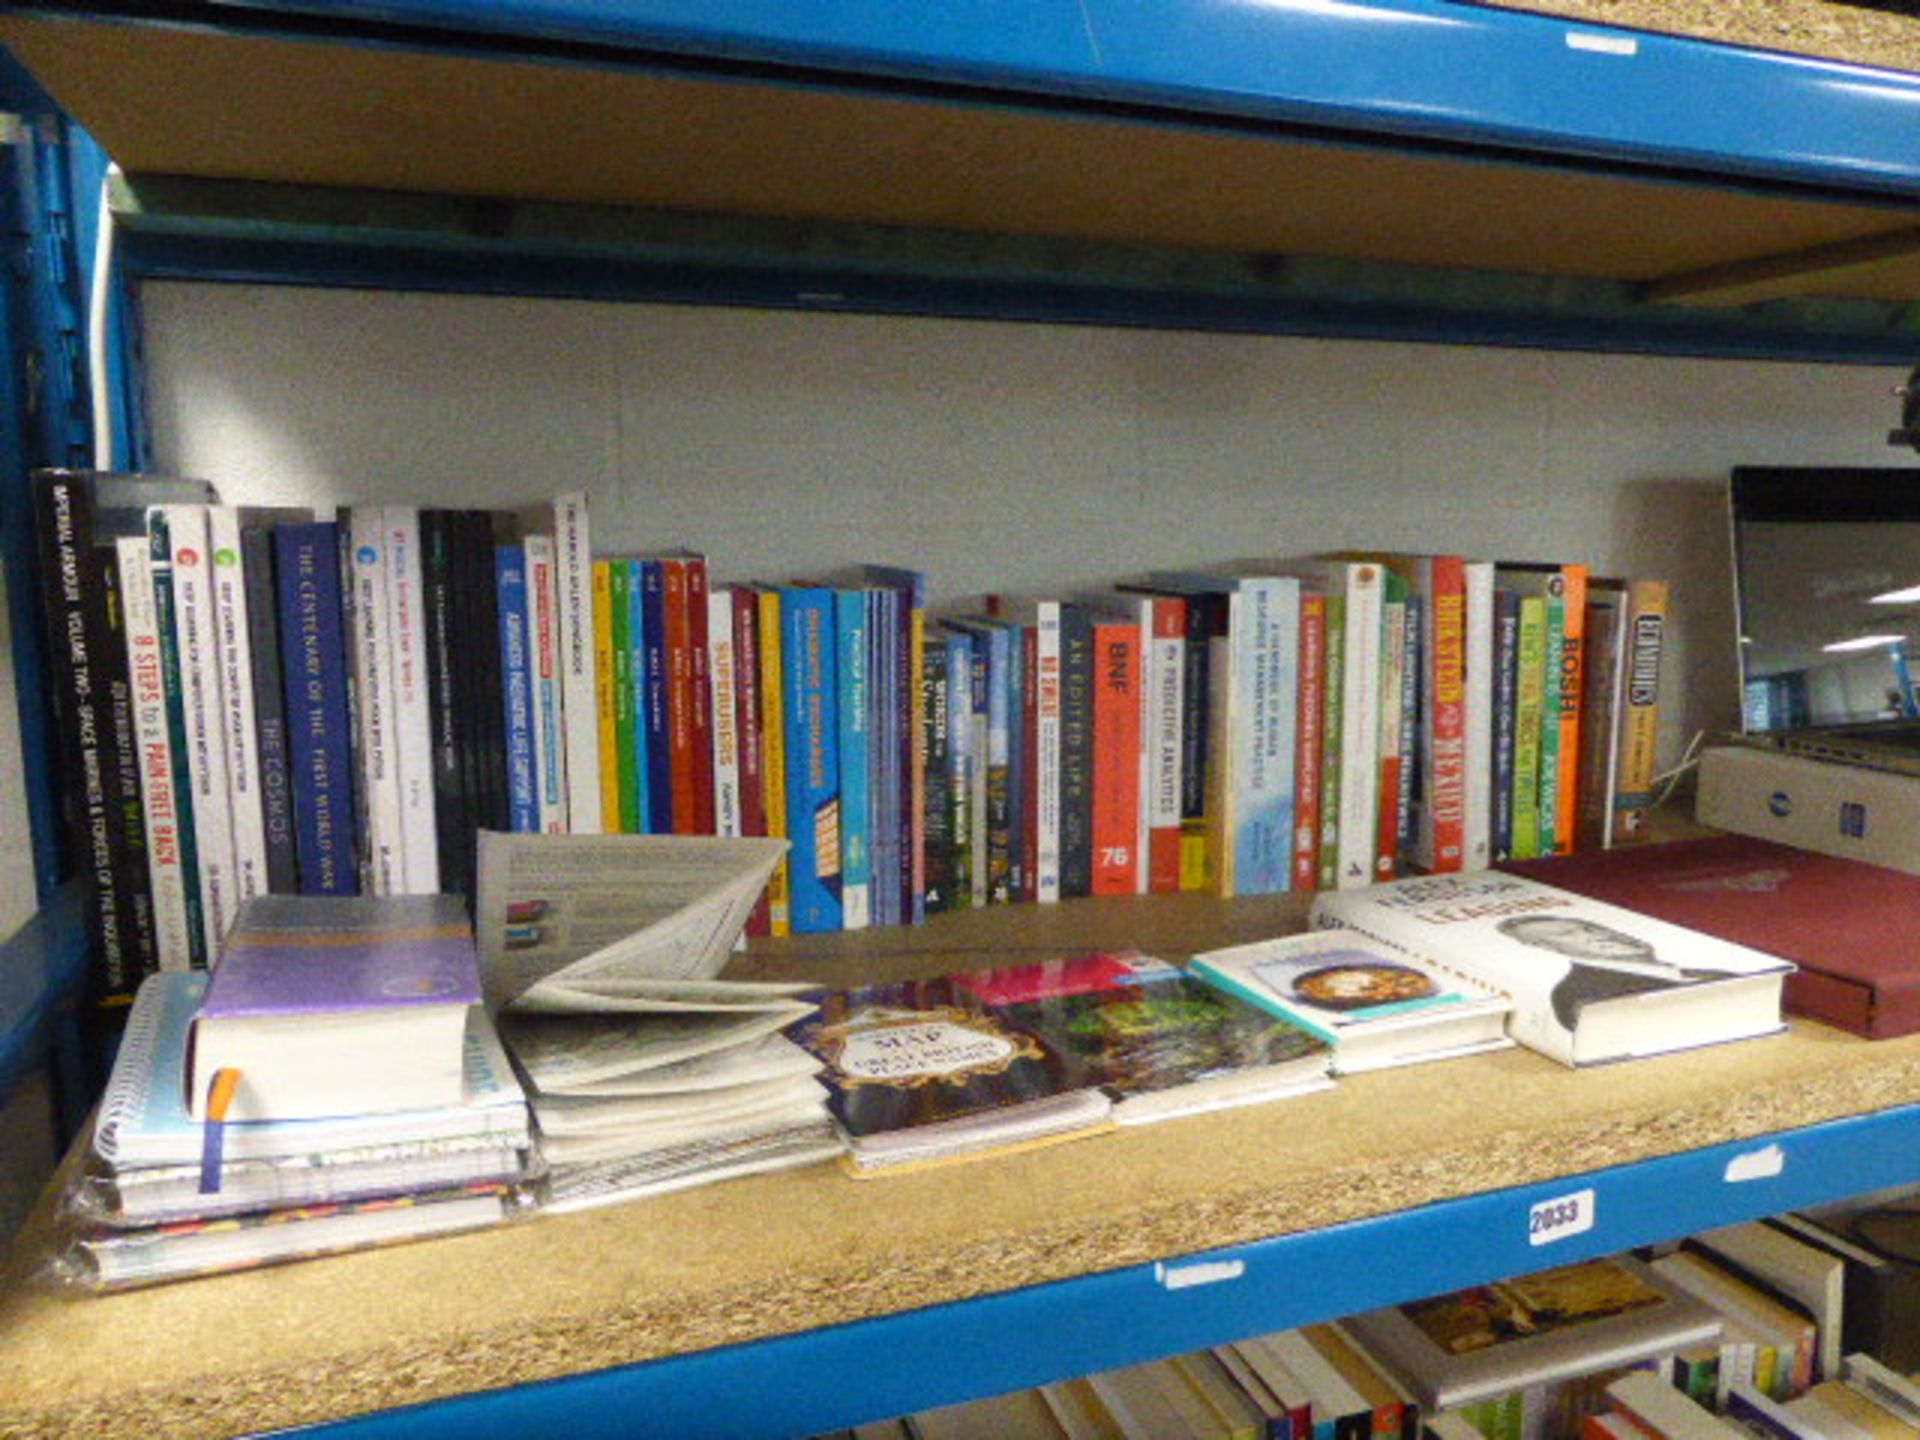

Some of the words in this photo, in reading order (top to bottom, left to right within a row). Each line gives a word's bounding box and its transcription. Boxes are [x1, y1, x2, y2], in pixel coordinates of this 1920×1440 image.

[53, 486, 72, 542] IMPERIAL
[61, 545, 79, 601] ARMOUR
[299, 545, 314, 576] THE
[67, 611, 88, 664] VOLUME
[301, 582, 321, 674] CENTENARY
[1256, 590, 1267, 649] RESOURCE
[135, 635, 156, 646] 8
[1069, 639, 1084, 665] AN
[74, 667, 91, 696] TWO
[136, 654, 161, 704] STEPS
[1041, 656, 1058, 674] NO
[1108, 642, 1129, 696] BNF
[308, 679, 323, 700] OF
[1068, 674, 1084, 745] EDITED
[1162, 668, 1178, 742] PREDICTIVE
[1254, 654, 1266, 733] MANAGEMENT
[77, 705, 97, 745] SPACE
[141, 707, 159, 723] to
[309, 710, 325, 737] THE
[263, 720, 281, 751] THE
[312, 749, 329, 788] FIRST
[1068, 755, 1083, 796] LIFE
[1161, 747, 1177, 815] ANALYTICS
[1434, 737, 1463, 821] MEXICO
[266, 757, 288, 845] COSMOS
[315, 795, 333, 852] WORLD
[155, 825, 178, 865] BACK
[1101, 847, 1128, 867] 76
[98, 870, 111, 886] OF
[320, 856, 336, 890] WAR
[100, 890, 115, 914] THE
[874, 1031, 941, 1049] MAP
[1533, 1201, 1578, 1233] 2033
